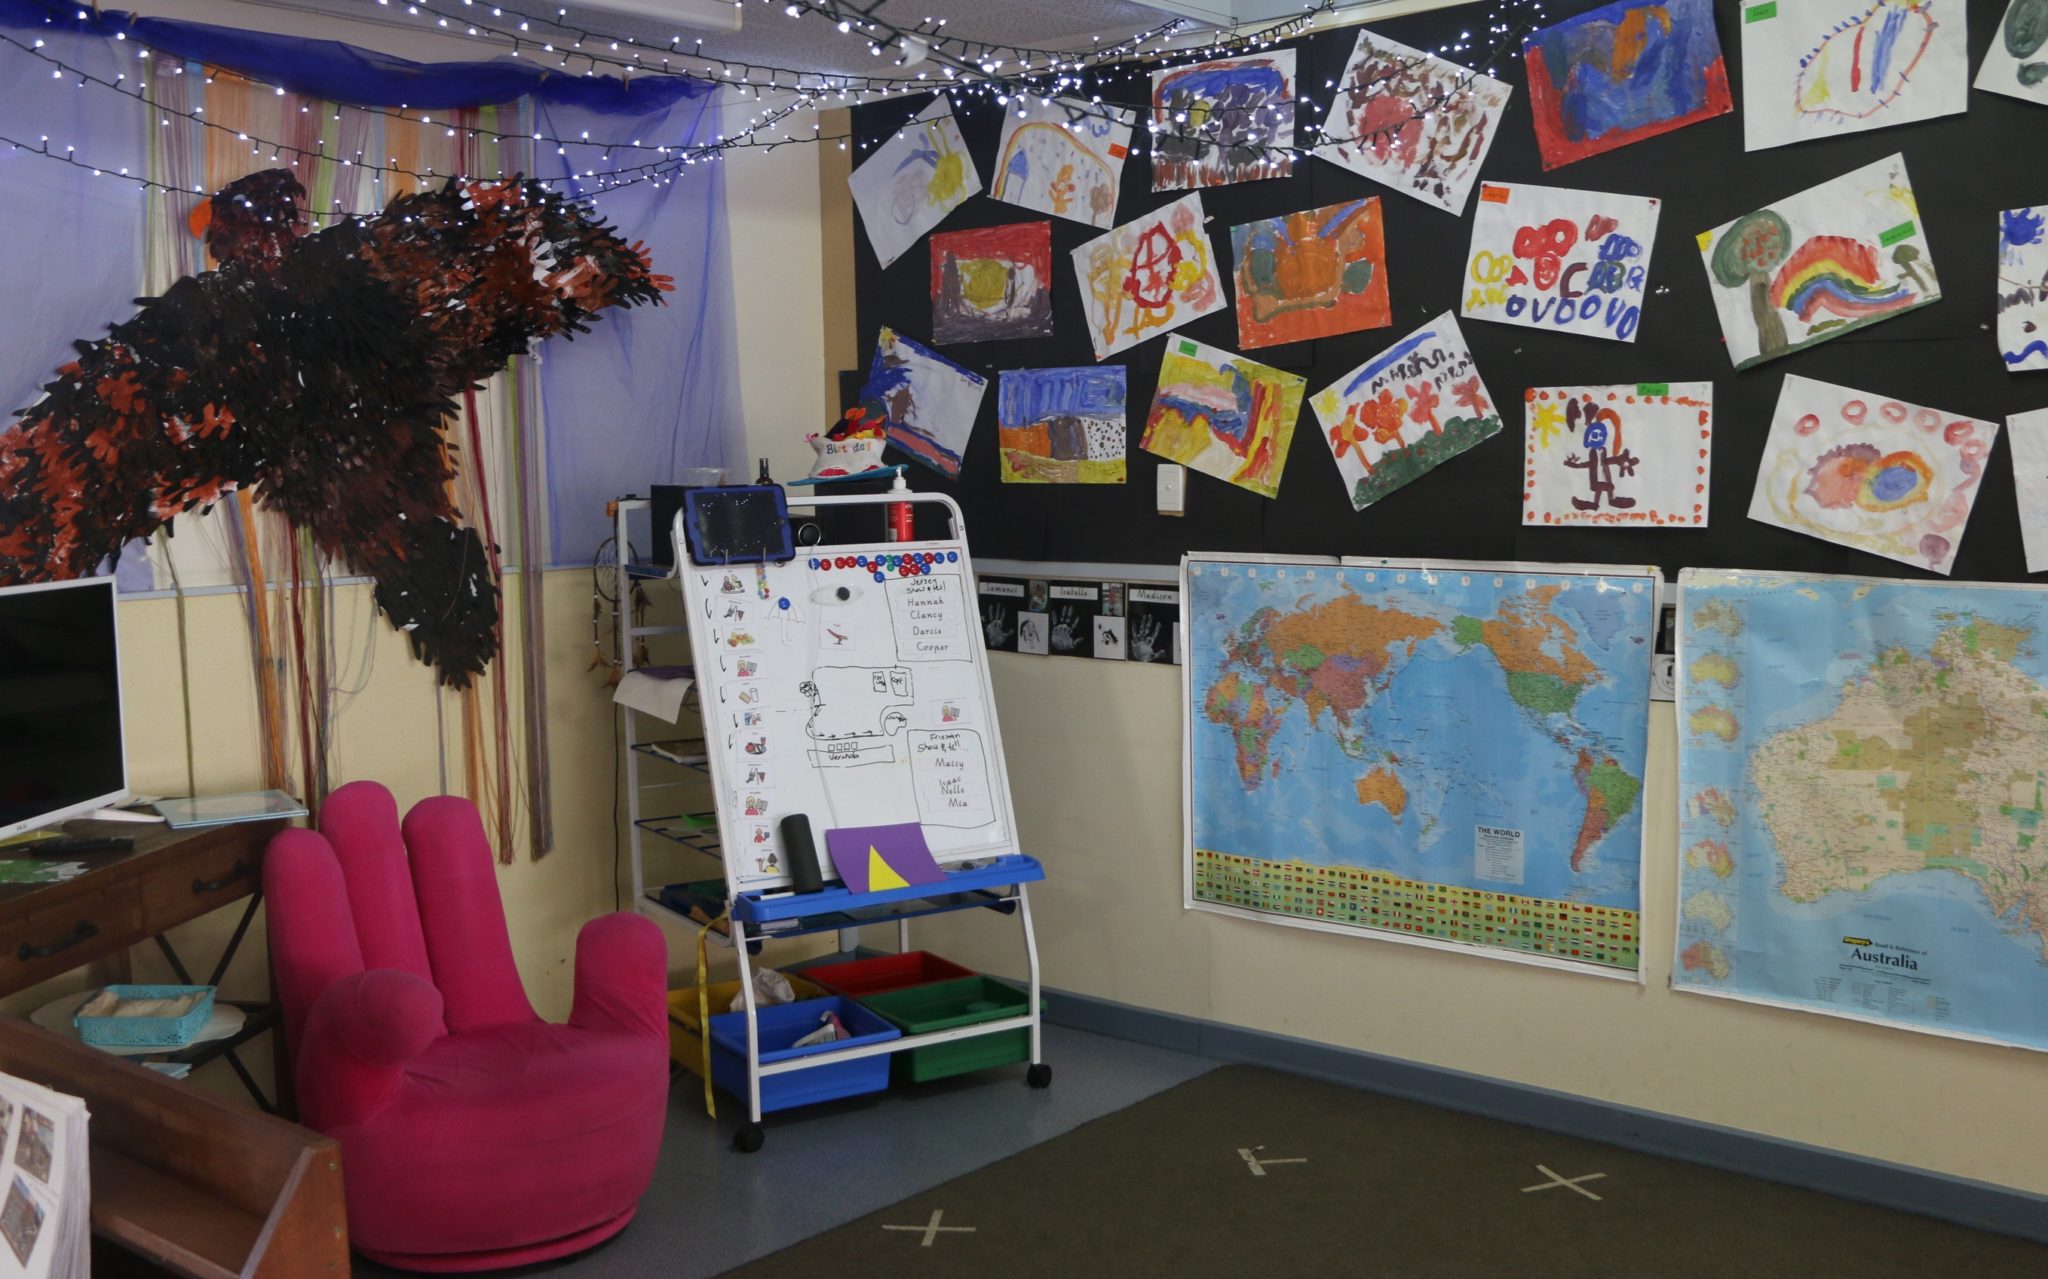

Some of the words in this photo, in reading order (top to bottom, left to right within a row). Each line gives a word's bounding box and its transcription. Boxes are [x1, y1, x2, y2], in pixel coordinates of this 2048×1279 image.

[910, 578, 937, 587] Jersey
[1137, 590, 1173, 601] Madison
[907, 596, 944, 607] Hannah
[910, 610, 943, 621] Clancy
[912, 626, 942, 636] Darcie
[916, 641, 950, 654] Cooper
[917, 743, 938, 753] Show
[934, 758, 964, 771] Maisy
[939, 776, 961, 787] Isaac
[948, 798, 968, 808] Mia
[1477, 826, 1491, 834] THE
[1493, 829, 1521, 838] WORLD
[1850, 947, 1919, 971] Australia
